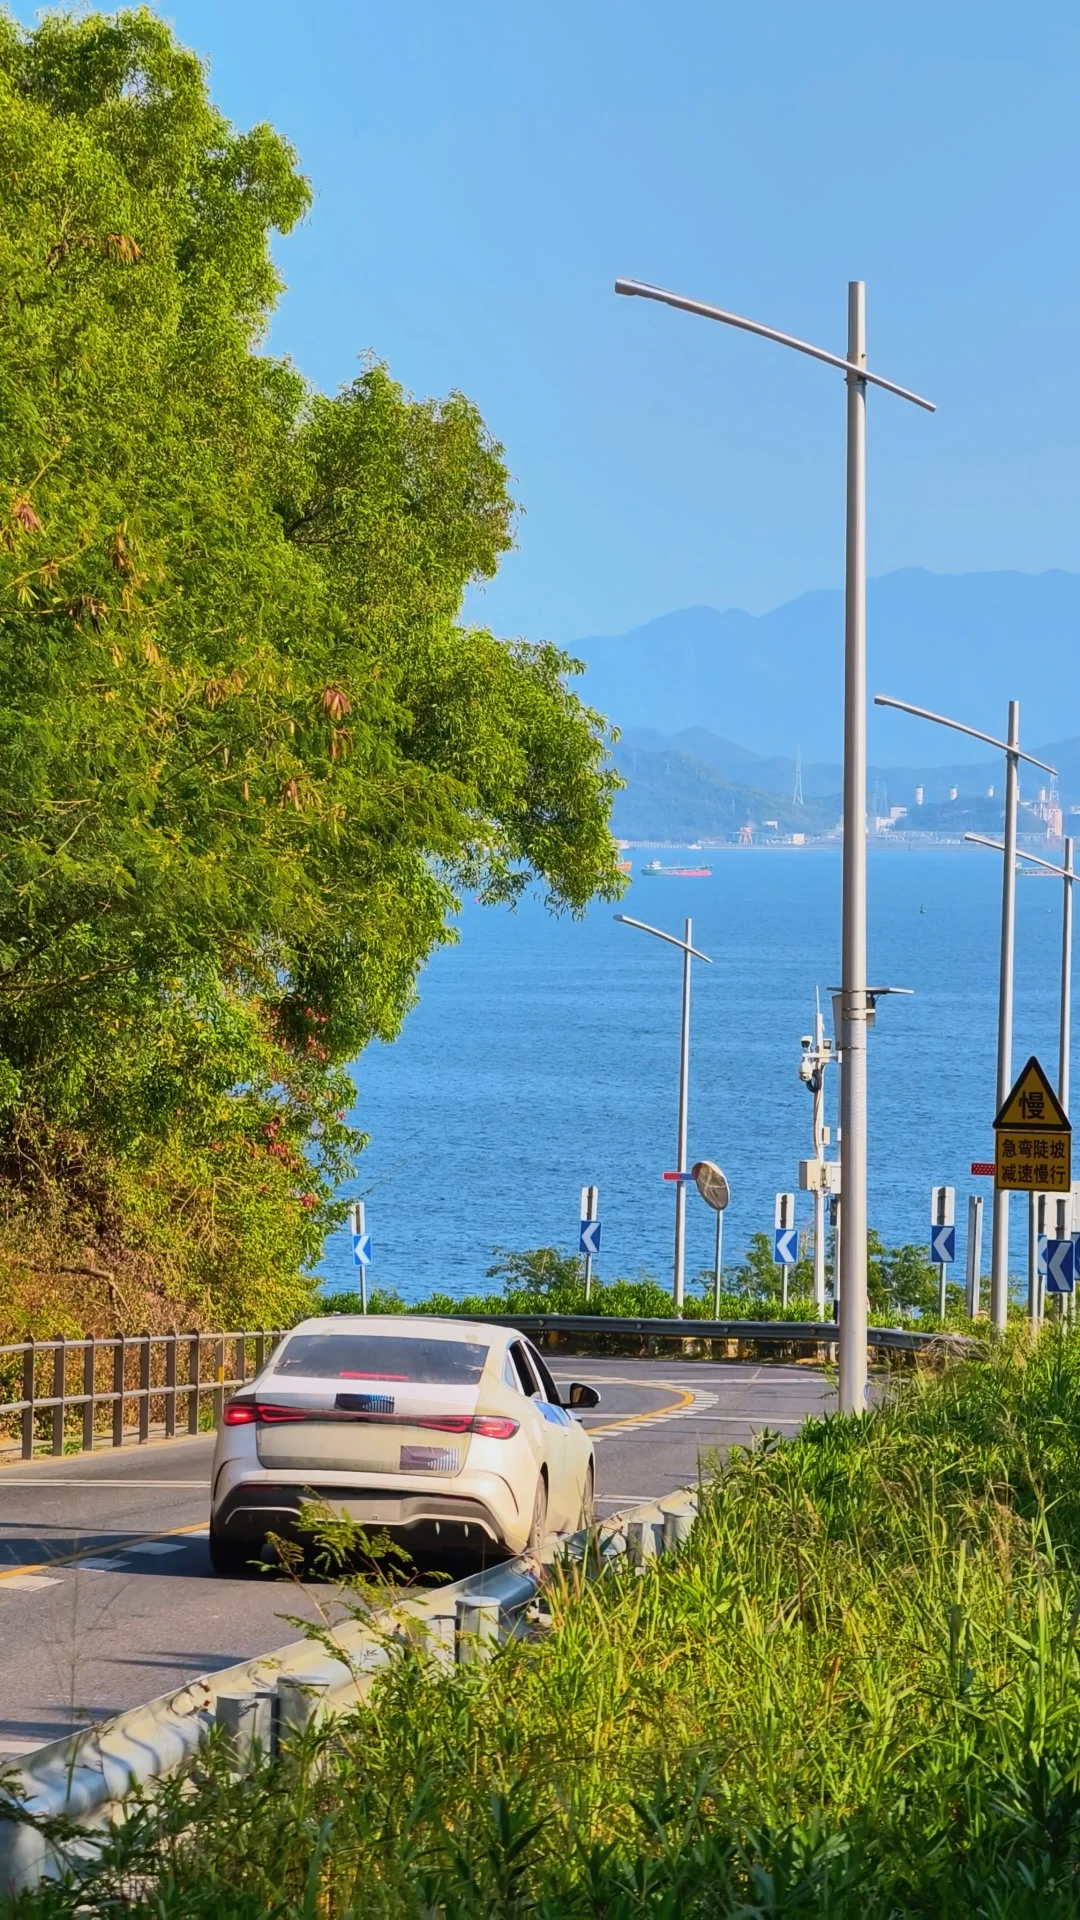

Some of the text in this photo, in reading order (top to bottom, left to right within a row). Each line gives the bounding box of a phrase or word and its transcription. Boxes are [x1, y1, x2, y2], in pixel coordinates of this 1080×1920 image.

[1018, 1091, 1045, 1120] 慢
[1001, 1138, 1066, 1159] 急弯陡坡
[1001, 1163, 1066, 1185] 减速慢行
